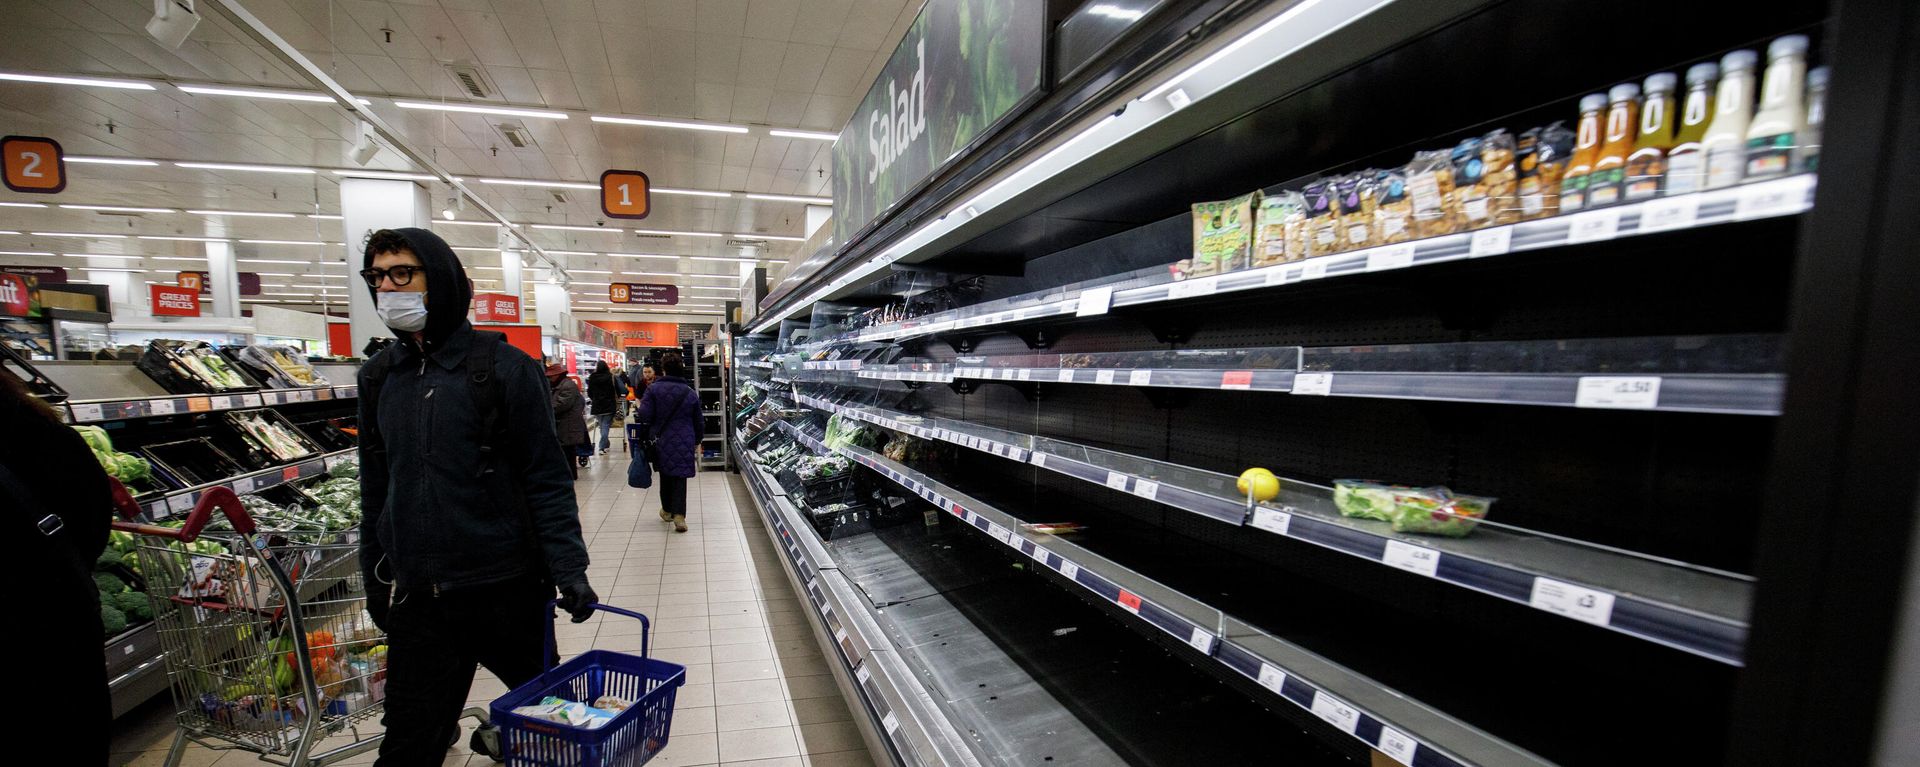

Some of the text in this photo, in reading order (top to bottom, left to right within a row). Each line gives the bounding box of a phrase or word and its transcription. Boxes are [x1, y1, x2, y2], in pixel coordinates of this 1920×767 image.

[869, 37, 926, 184] Salad
[20, 151, 44, 178] 2
[617, 183, 633, 206] 1
[181, 277, 198, 288] 17
[159, 292, 192, 302] GREAT
[612, 288, 627, 299] 19
[158, 300, 194, 310] PRICES
[495, 300, 515, 309] GREAT
[495, 307, 516, 316] PRICES
[1577, 593, 1596, 608] £3
